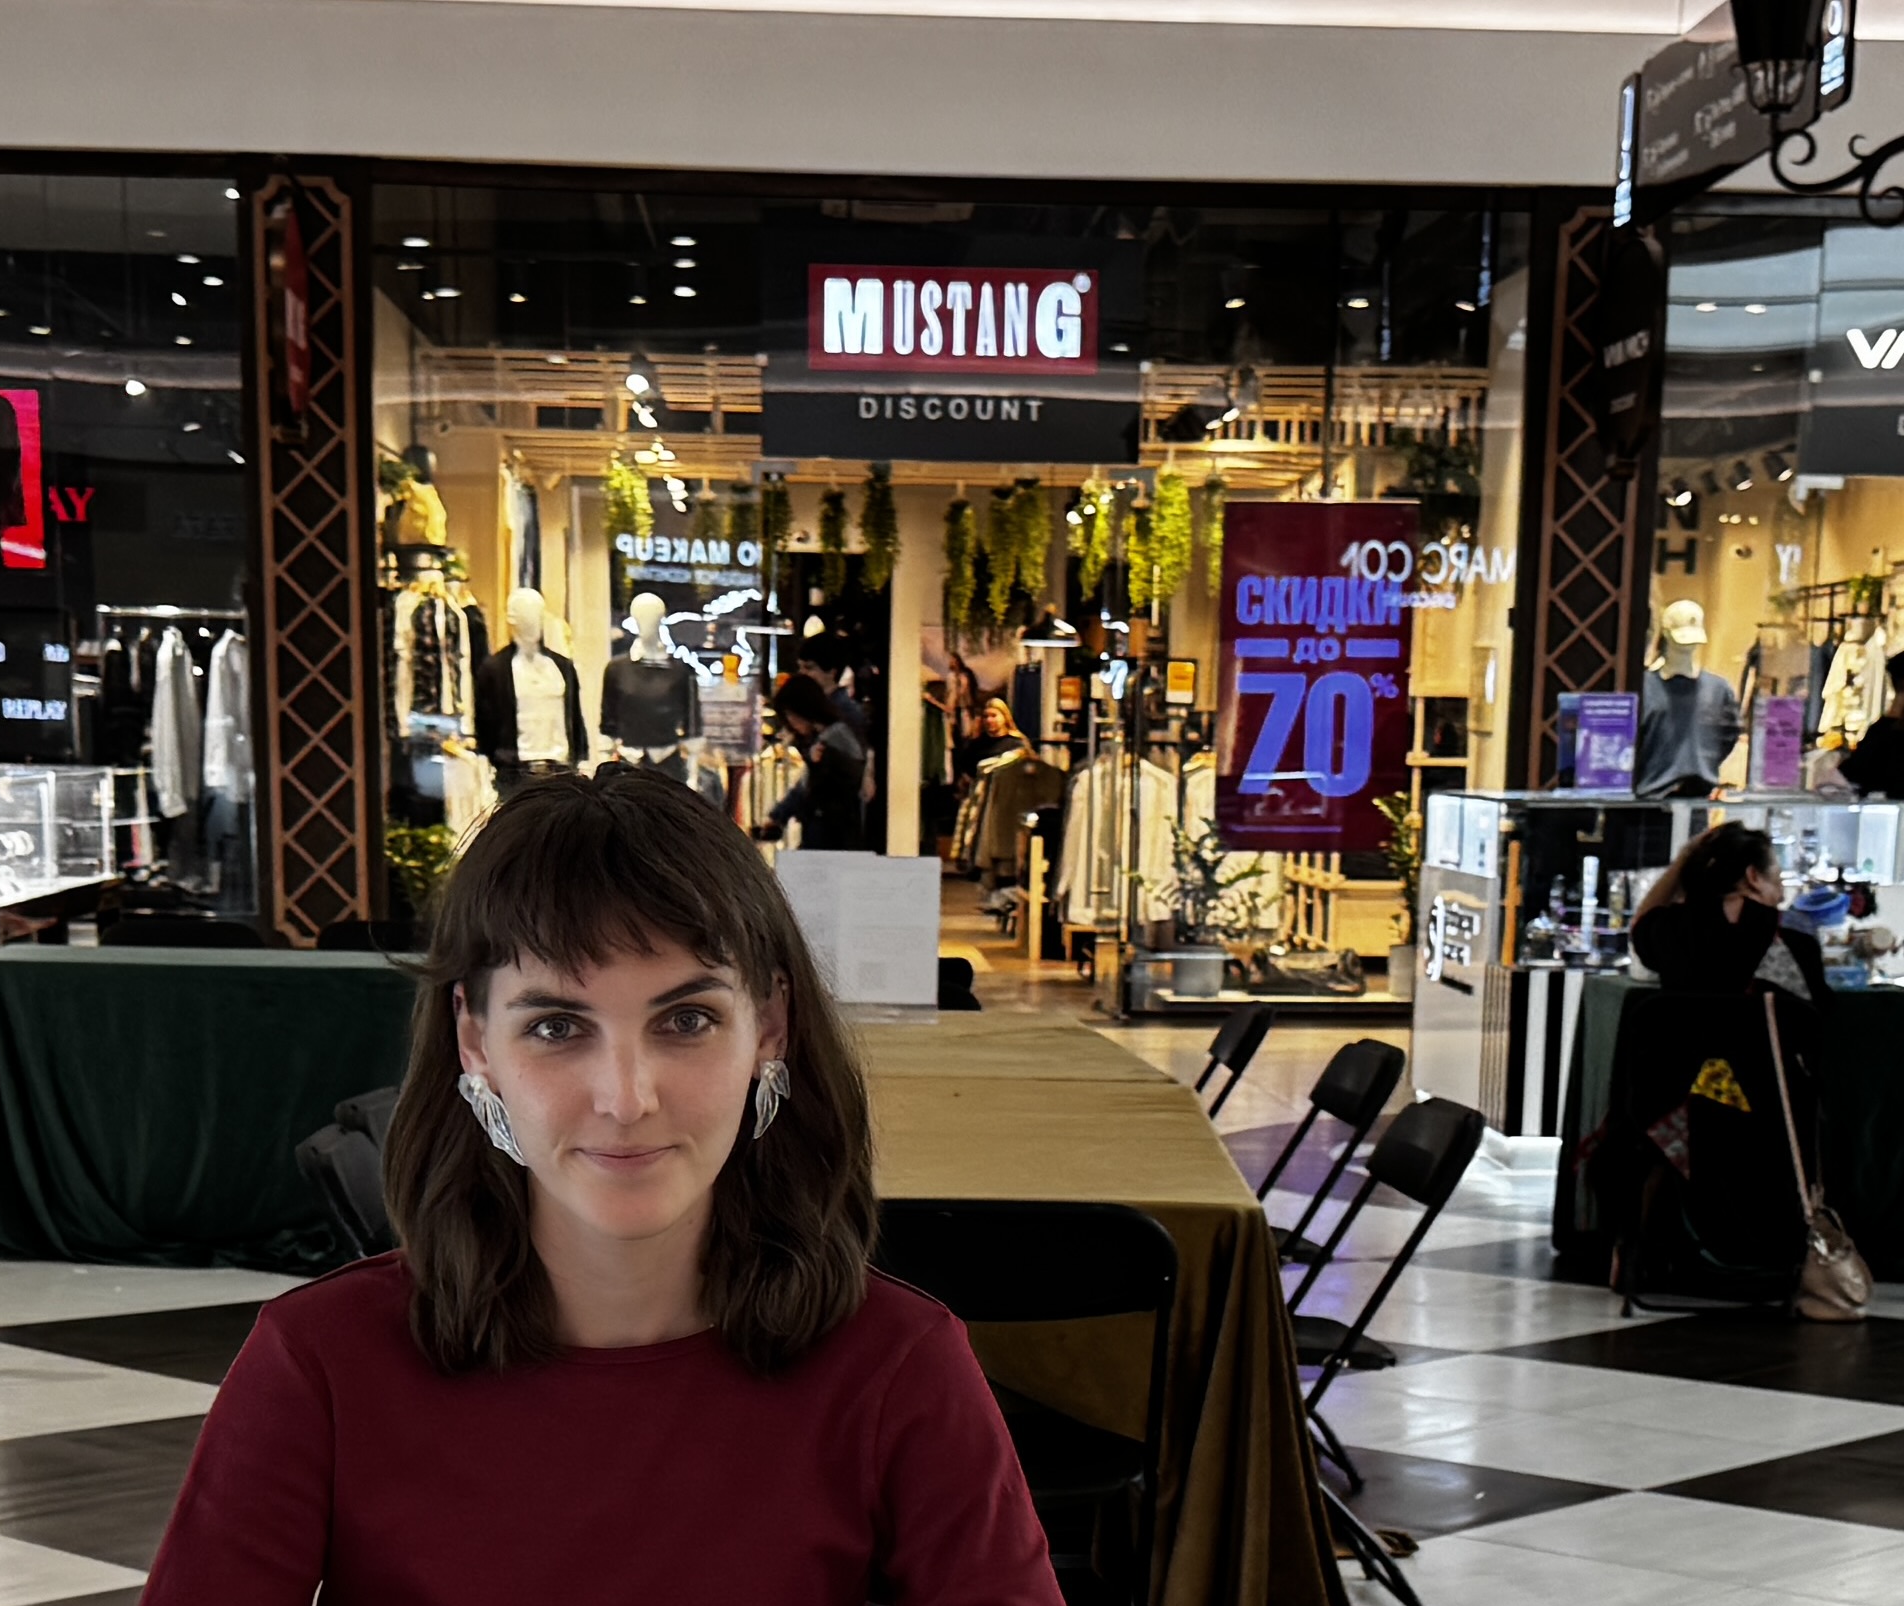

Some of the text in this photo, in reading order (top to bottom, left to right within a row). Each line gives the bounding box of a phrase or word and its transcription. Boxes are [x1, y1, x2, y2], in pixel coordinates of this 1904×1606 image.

[823, 276, 1083, 359] MUSTANG
[858, 397, 1044, 422] DISCOUNT
[1237, 575, 1402, 634] СКИДКИ
[1293, 638, 1340, 663] ДО
